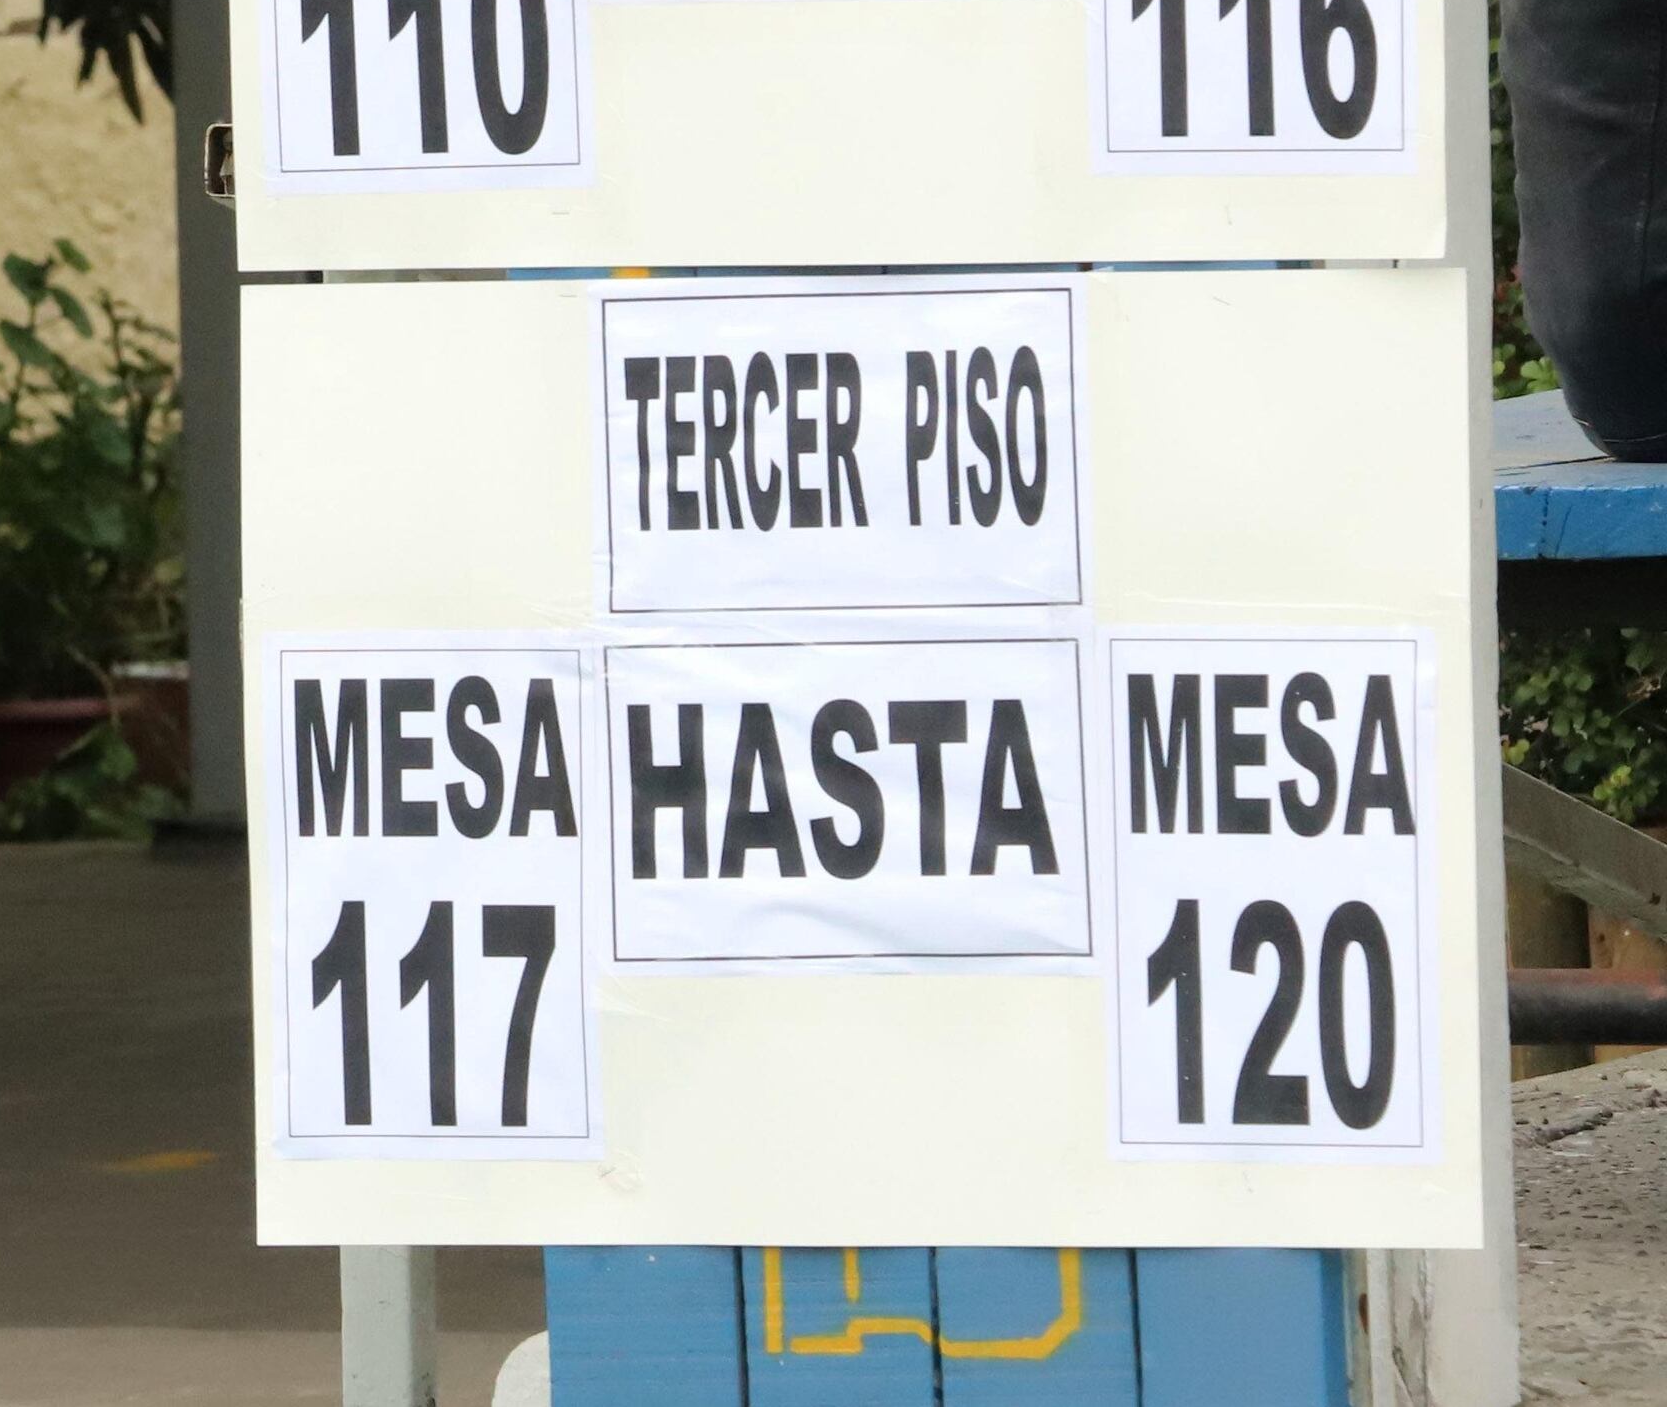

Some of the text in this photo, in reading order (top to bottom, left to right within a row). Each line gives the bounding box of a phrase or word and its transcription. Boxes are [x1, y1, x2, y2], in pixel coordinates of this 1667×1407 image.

[624, 345, 1048, 532] TERCER PISO
[294, 675, 579, 839] MESA
[627, 699, 1059, 880] HASTA
[1127, 672, 1417, 837] MESA
[311, 900, 557, 1127] 117
[1147, 899, 1396, 1130] 120
